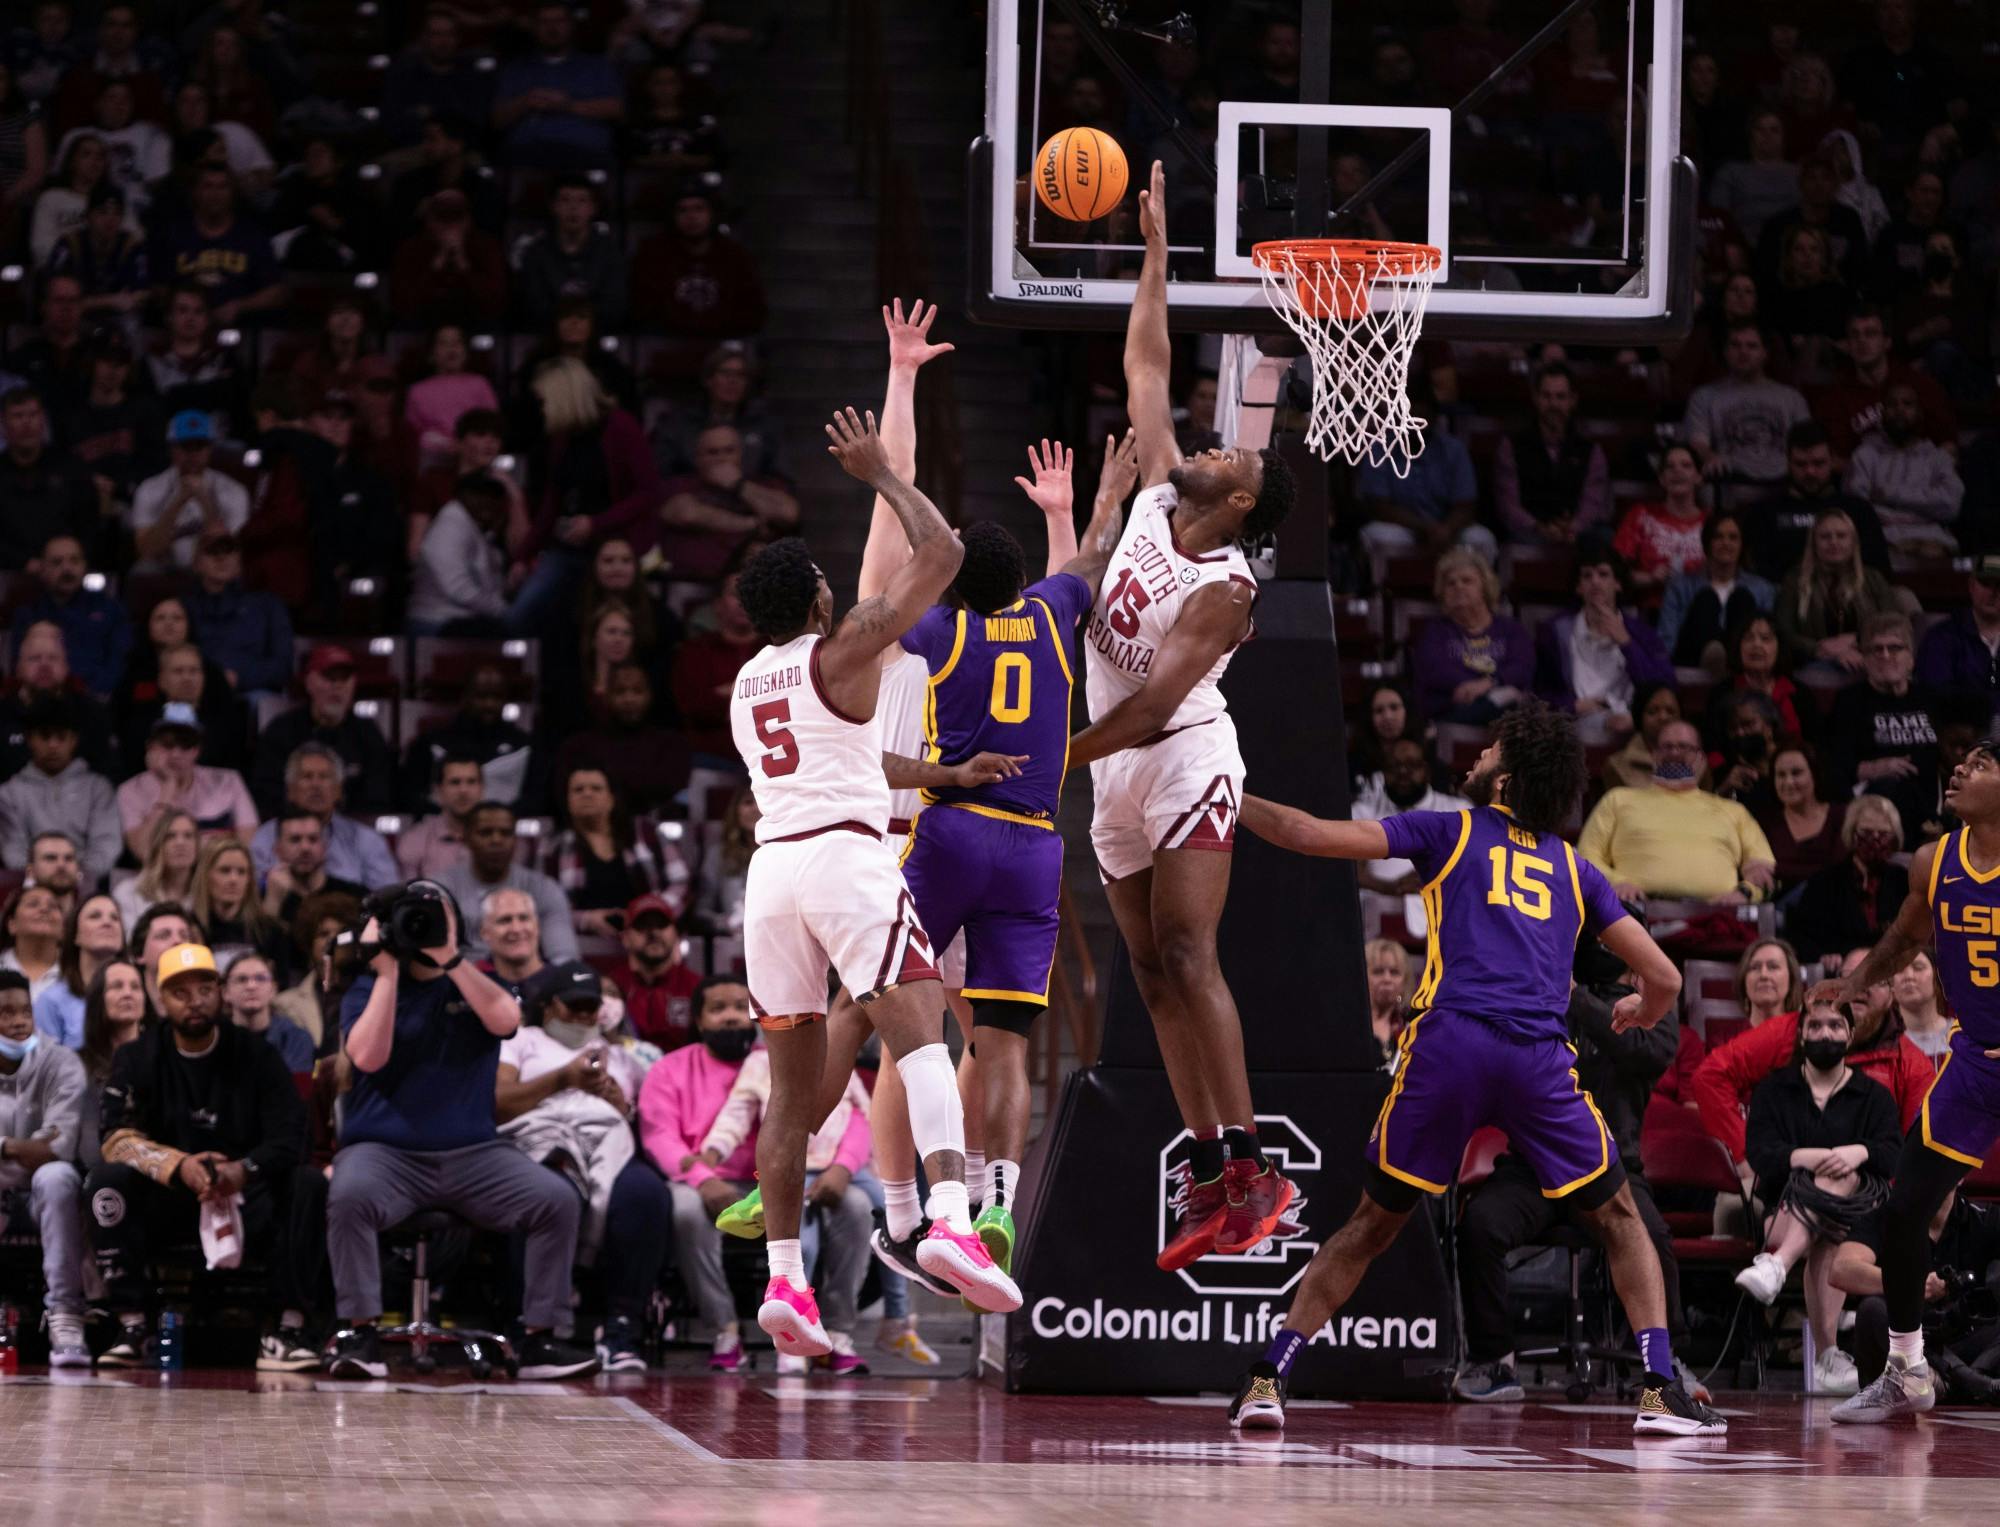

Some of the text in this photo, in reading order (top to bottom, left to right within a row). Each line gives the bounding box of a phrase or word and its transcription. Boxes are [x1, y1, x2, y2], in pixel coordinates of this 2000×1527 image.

[1043, 140, 1061, 201] Wilson
[1019, 282, 1083, 298] SPALDING
[1124, 535, 1178, 604] SOUTH
[1106, 567, 1151, 640] 15
[1087, 610, 1155, 674] AROLINA
[738, 665, 802, 699] COUISNARD
[990, 651, 1032, 724] 0
[752, 698, 800, 778] 5
[1487, 845, 1553, 921] 15
[1967, 940, 2000, 988] 5
[1031, 1296, 1211, 1342] Colonial
[1307, 1315, 1437, 1350] Arena
